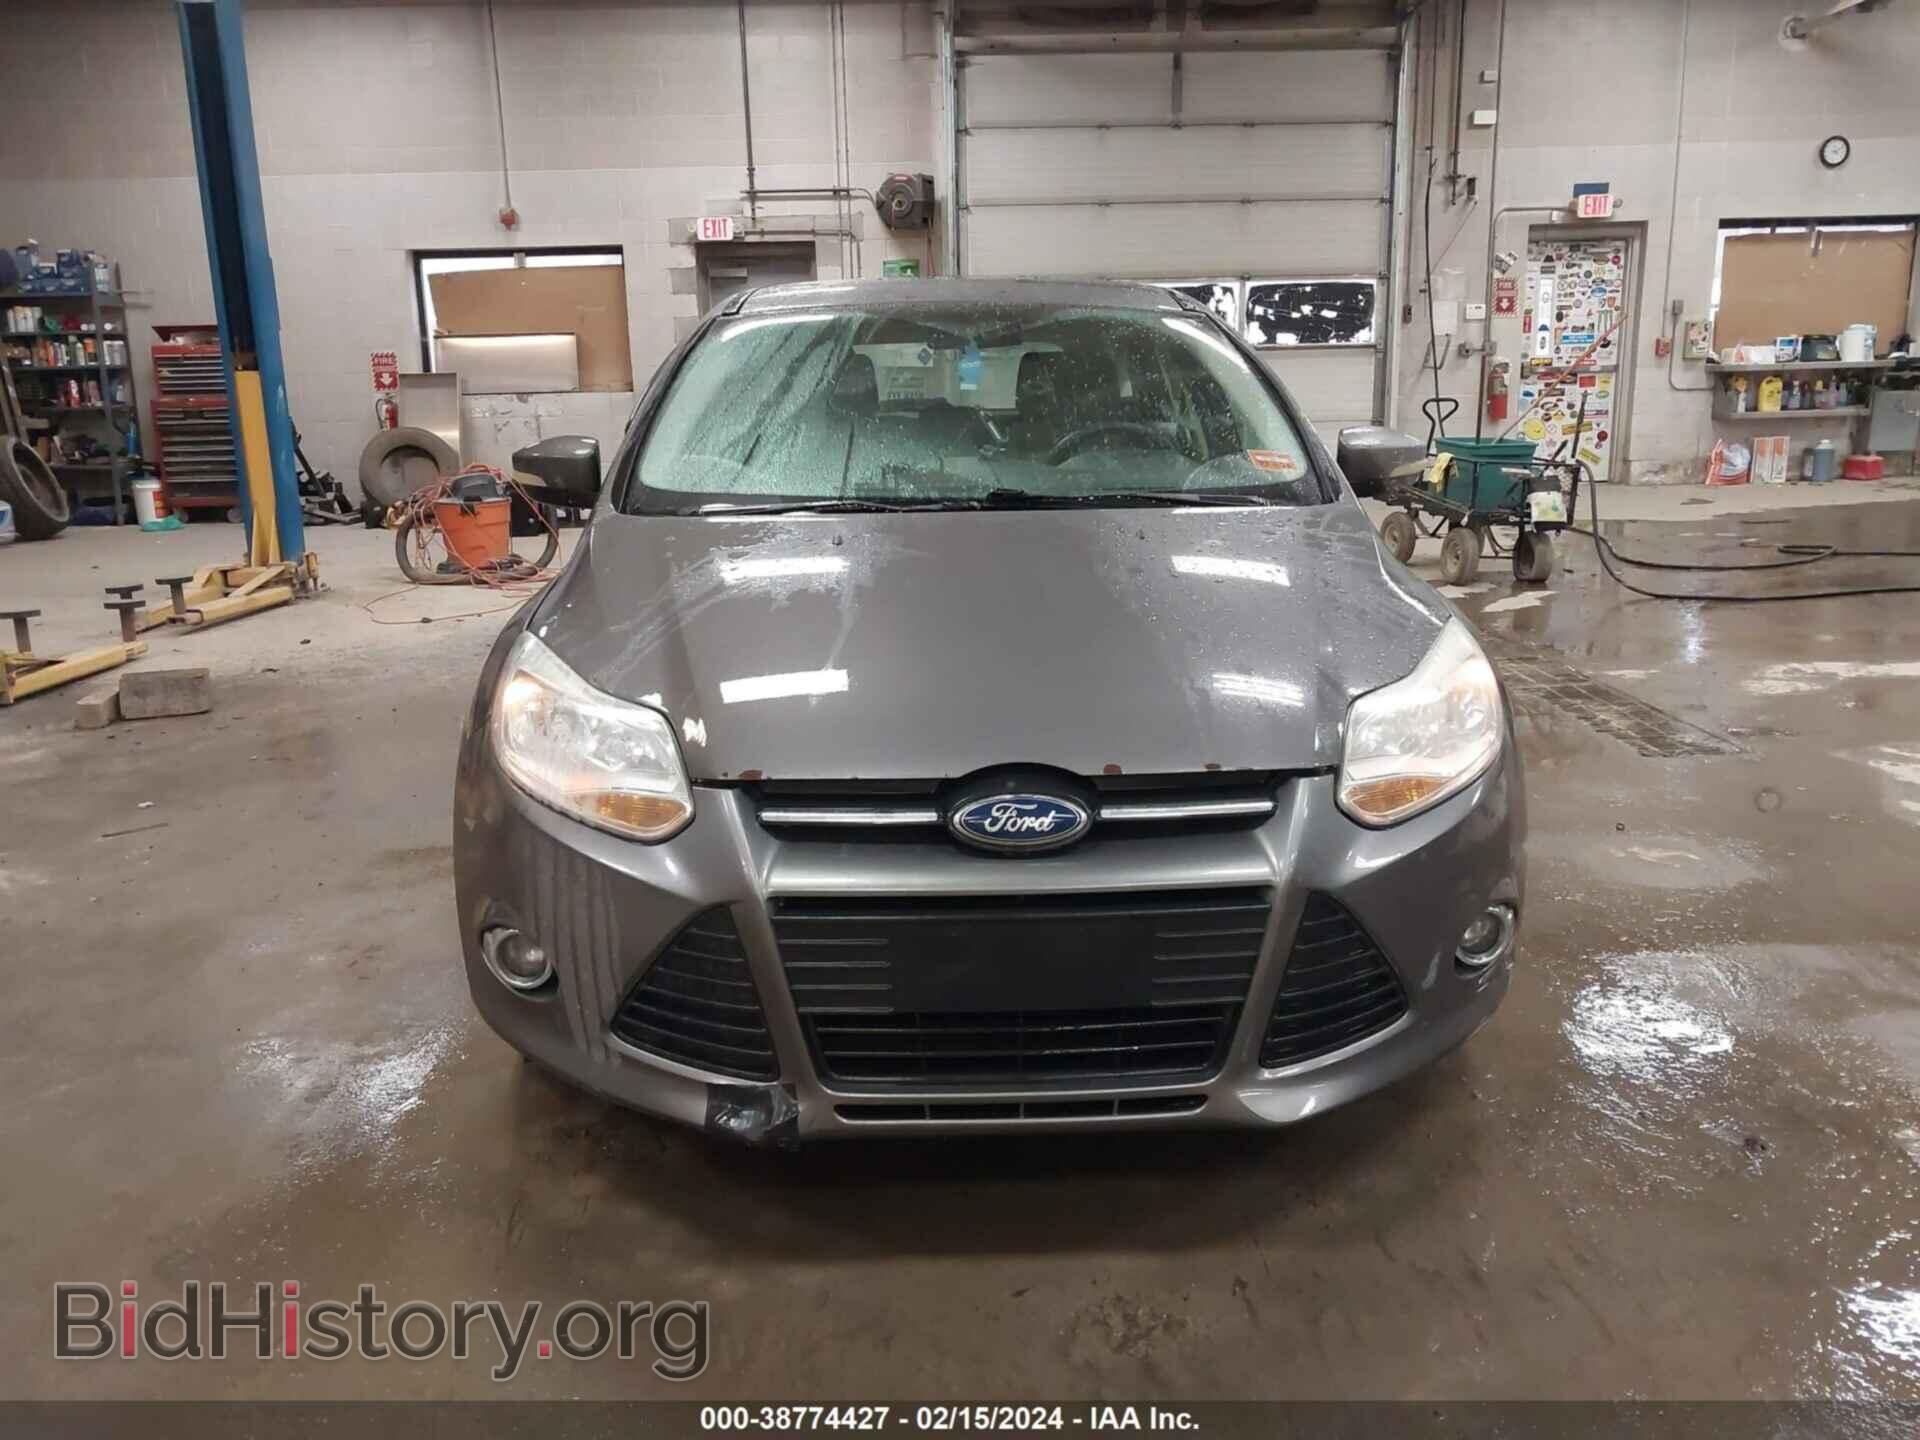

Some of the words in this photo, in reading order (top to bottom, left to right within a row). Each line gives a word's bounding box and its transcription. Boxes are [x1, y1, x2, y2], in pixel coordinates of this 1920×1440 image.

[1584, 195, 1608, 215] EXIT
[703, 218, 728, 239] EXIT
[374, 356, 394, 365] FIRE
[984, 802, 1056, 832] Ford
